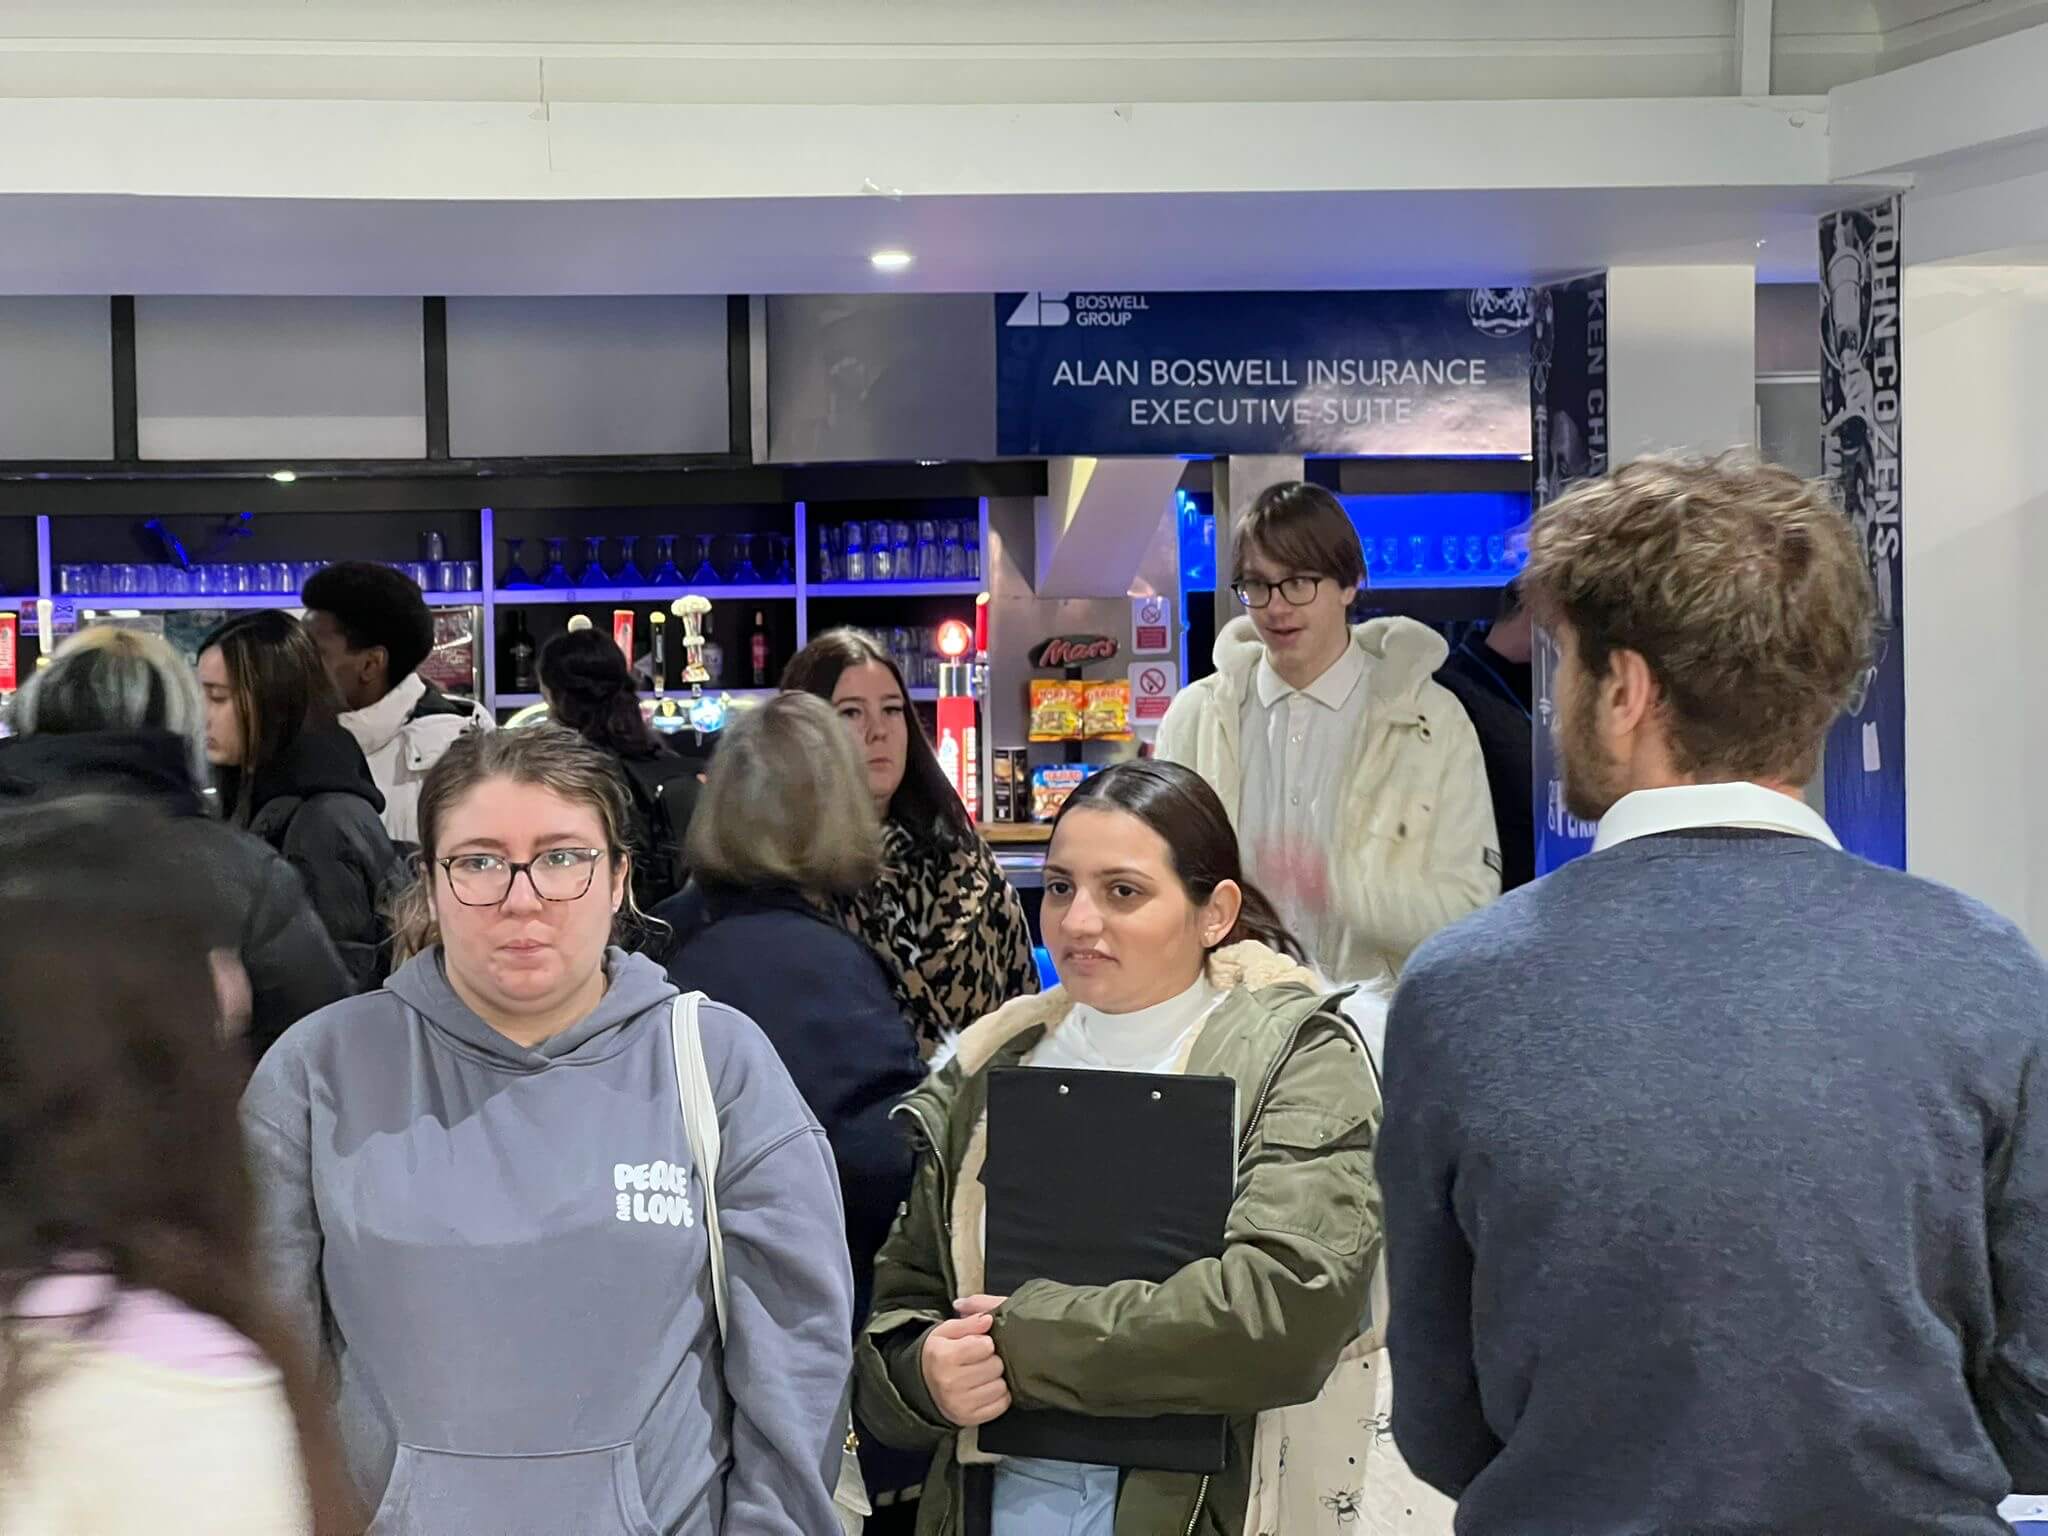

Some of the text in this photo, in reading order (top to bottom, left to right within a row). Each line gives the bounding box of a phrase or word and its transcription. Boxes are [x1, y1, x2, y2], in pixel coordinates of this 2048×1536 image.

[1075, 295, 1149, 310] BOSWELL
[1076, 311, 1132, 327] GROUP
[1052, 358, 1487, 386] ALAN BOSWELL INSURANCE
[1587, 287, 1607, 477] KEN CHA
[1871, 196, 1900, 559] JOHN COZENS
[1130, 398, 1411, 426] EXECUTIVE SUITE
[1039, 639, 1116, 668] Mars
[613, 1160, 688, 1197] PEACE
[633, 1192, 695, 1229] LOVE
